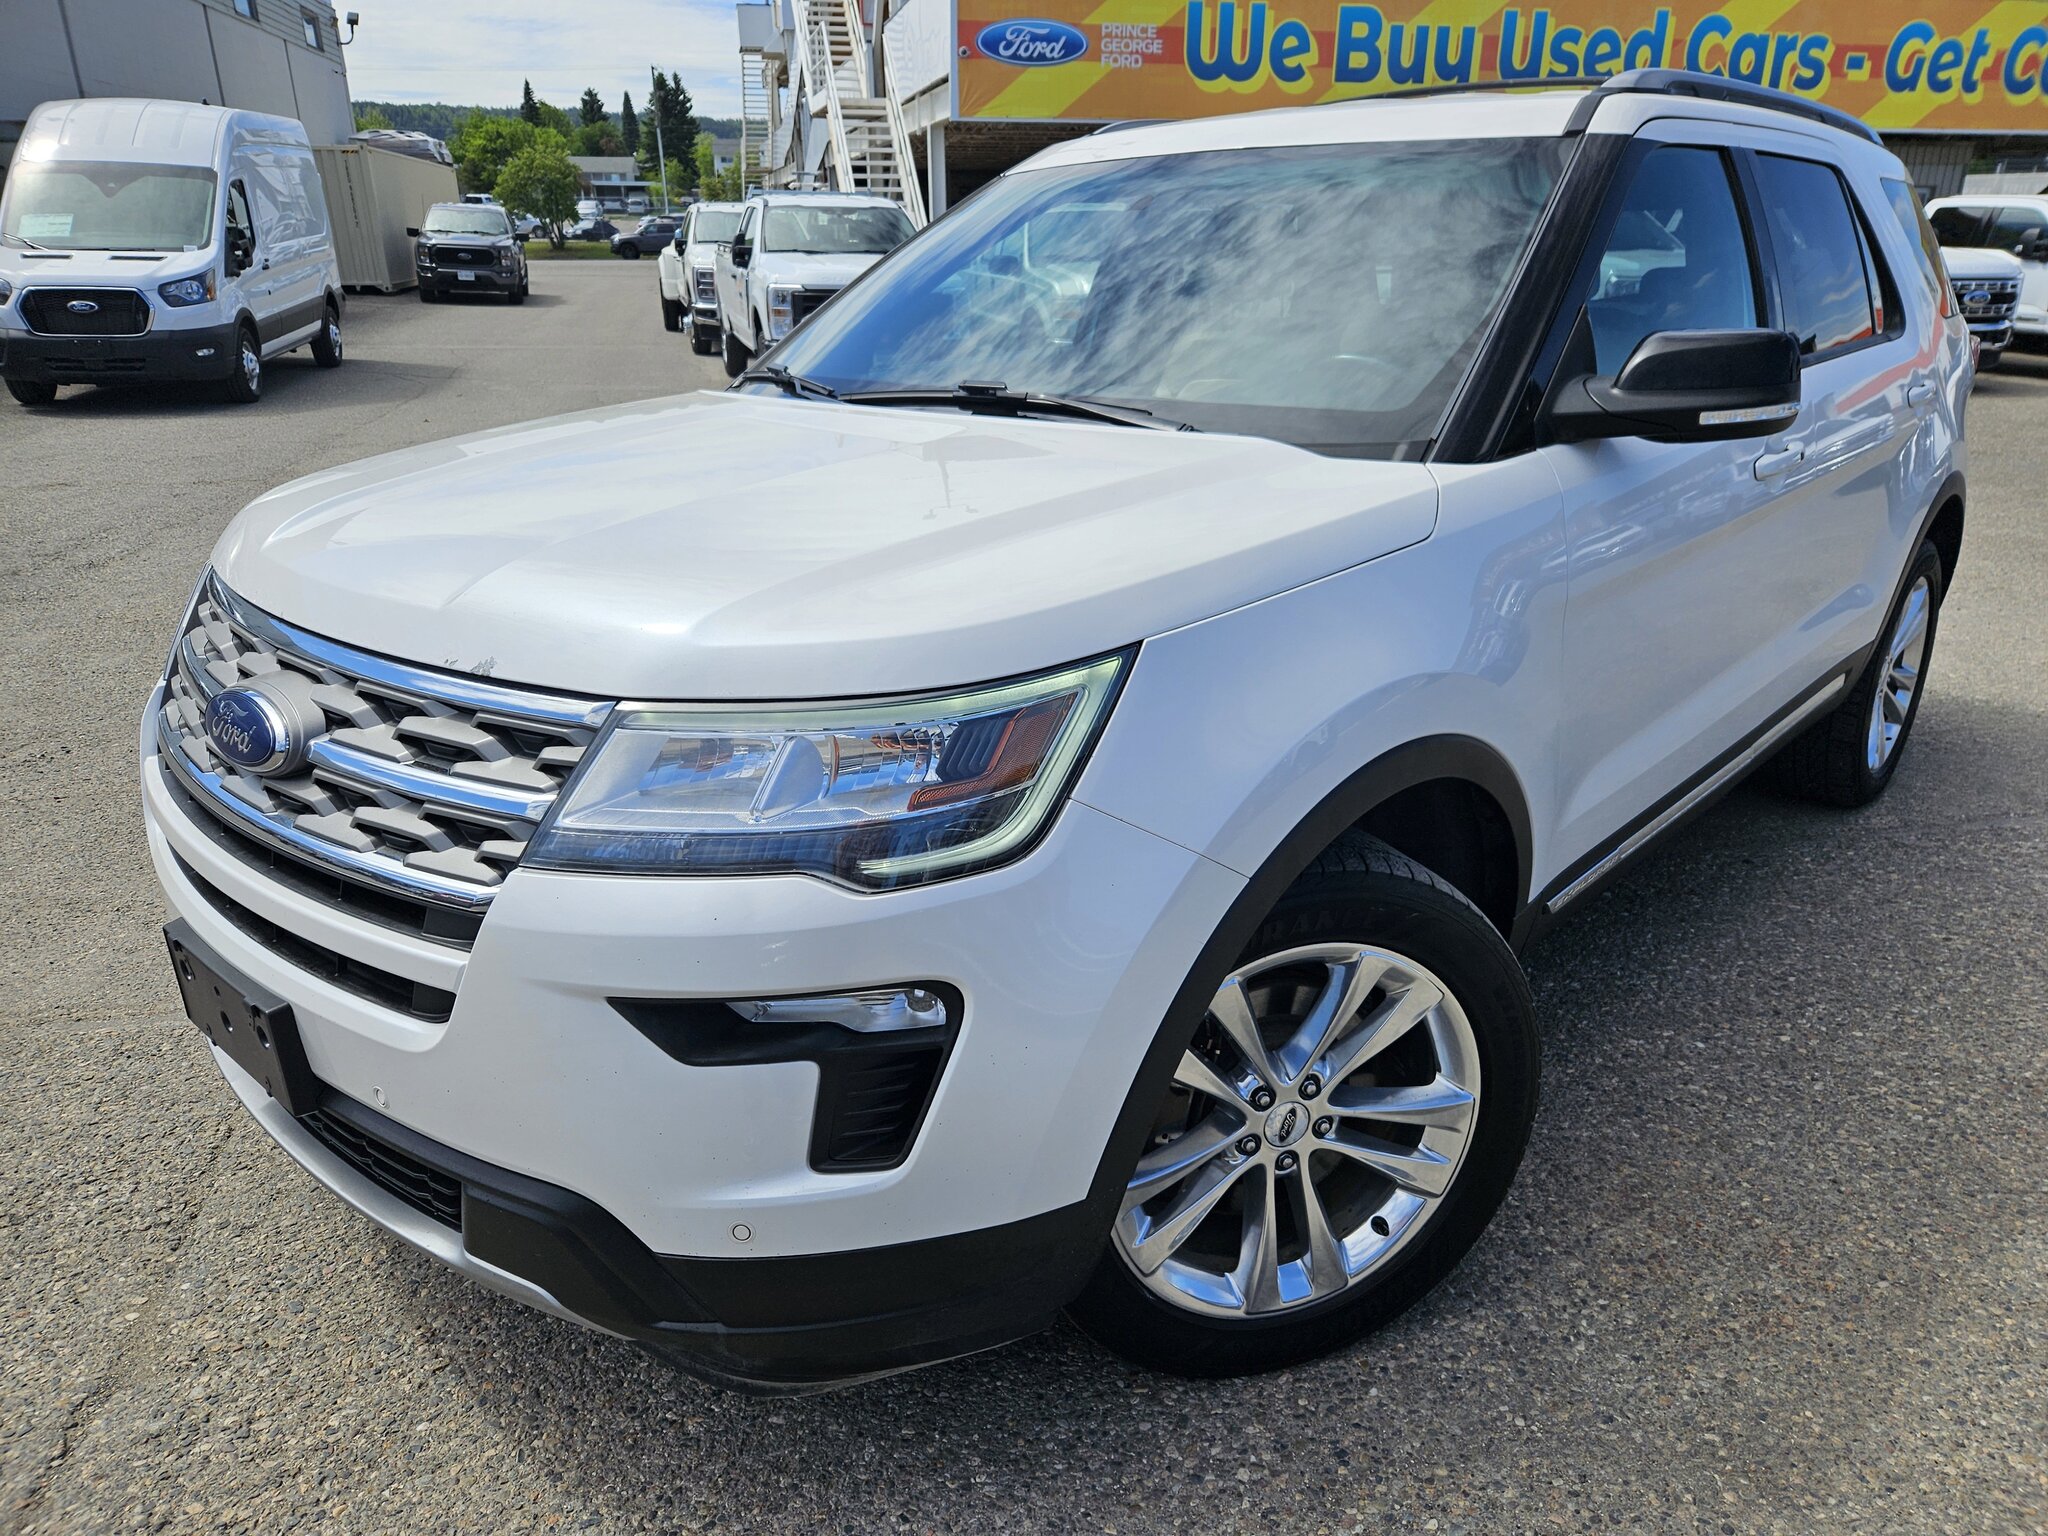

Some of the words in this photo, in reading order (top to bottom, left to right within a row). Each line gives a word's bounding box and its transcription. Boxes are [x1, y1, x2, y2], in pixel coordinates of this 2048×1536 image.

[998, 25, 1067, 59] Ford
[1101, 23, 1157, 38] PRINCE
[1101, 39, 1163, 54] GEORGE
[1185, 0, 1311, 82] We
[1333, 5, 1477, 84] Buy
[1499, 9, 1670, 80] Used
[1686, 14, 1829, 91] Cars
[1885, 21, 1991, 93] Get
[1101, 54, 1143, 69] FORD
[212, 699, 257, 754] Ford
[1280, 1112, 1296, 1138] Ford
